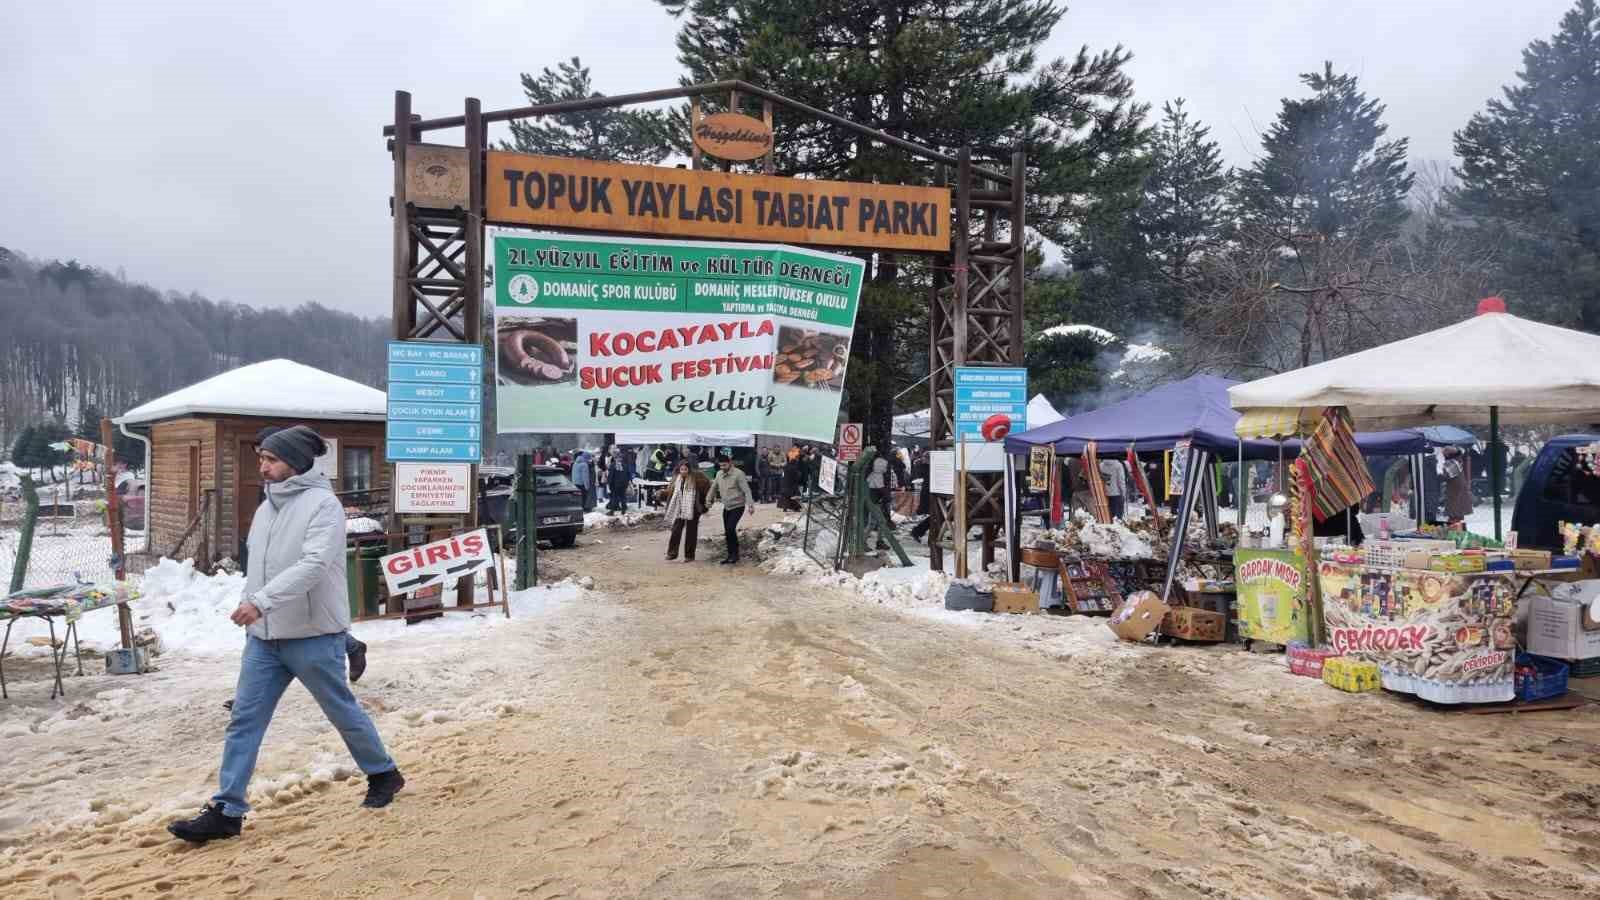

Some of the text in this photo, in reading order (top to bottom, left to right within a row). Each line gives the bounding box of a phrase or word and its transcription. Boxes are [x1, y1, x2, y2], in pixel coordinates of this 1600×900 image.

[504, 170, 614, 214] TOPUK
[621, 179, 743, 223] YAYLASI
[859, 198, 938, 236] PARKI
[609, 248, 673, 272] EĞİTİM
[680, 260, 700, 274] ve
[707, 255, 774, 277] KÜLTÜR
[779, 262, 851, 288] DERNEĞİ
[544, 280, 599, 301] DOMANİÇ
[602, 284, 631, 299] SPOR
[634, 283, 677, 301] KULÜBÜ
[694, 281, 740, 301] DOMANİÇ
[816, 293, 848, 310] OKULU
[722, 302, 756, 313] YAPTIRMA
[589, 319, 775, 357] KOCAYAYLA
[579, 364, 663, 390] SUCUK
[583, 397, 651, 420] Hoş
[387, 535, 483, 575] GİRİŞ
[1334, 624, 1428, 655] ÇEKİRDEK
